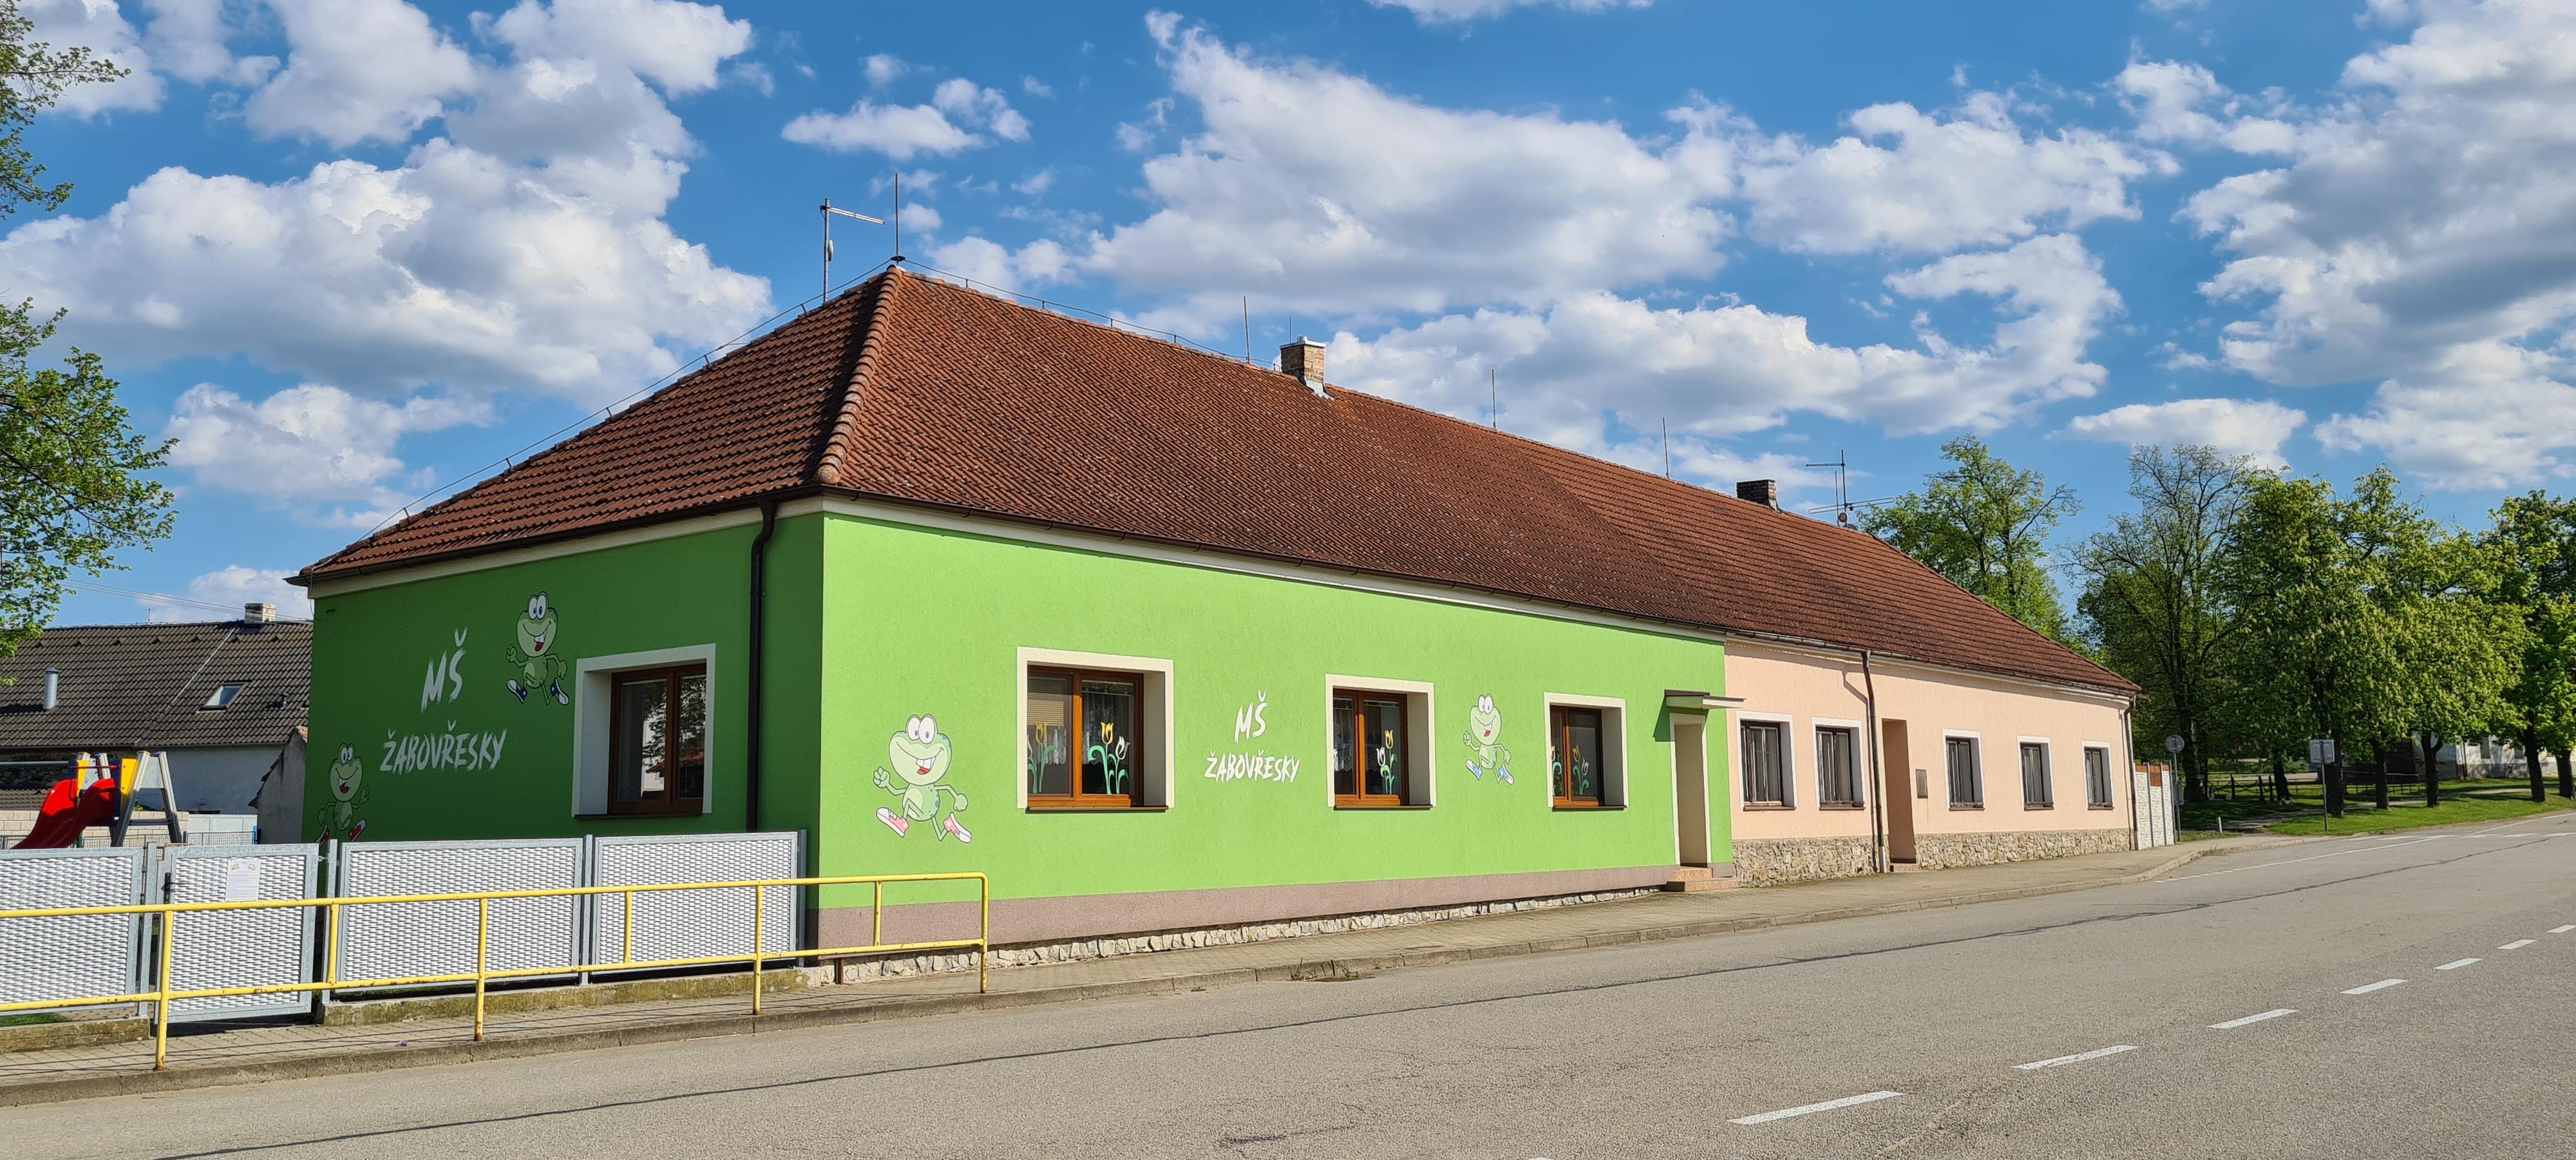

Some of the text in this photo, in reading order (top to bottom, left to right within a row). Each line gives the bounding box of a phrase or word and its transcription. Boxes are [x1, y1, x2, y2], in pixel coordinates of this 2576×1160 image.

[421, 627, 468, 713] MŠ
[1235, 690, 1269, 746] MŠ
[380, 719, 507, 775] ŽABOVŘESKY
[1204, 749, 1300, 783] ŽABOVŘESKY
